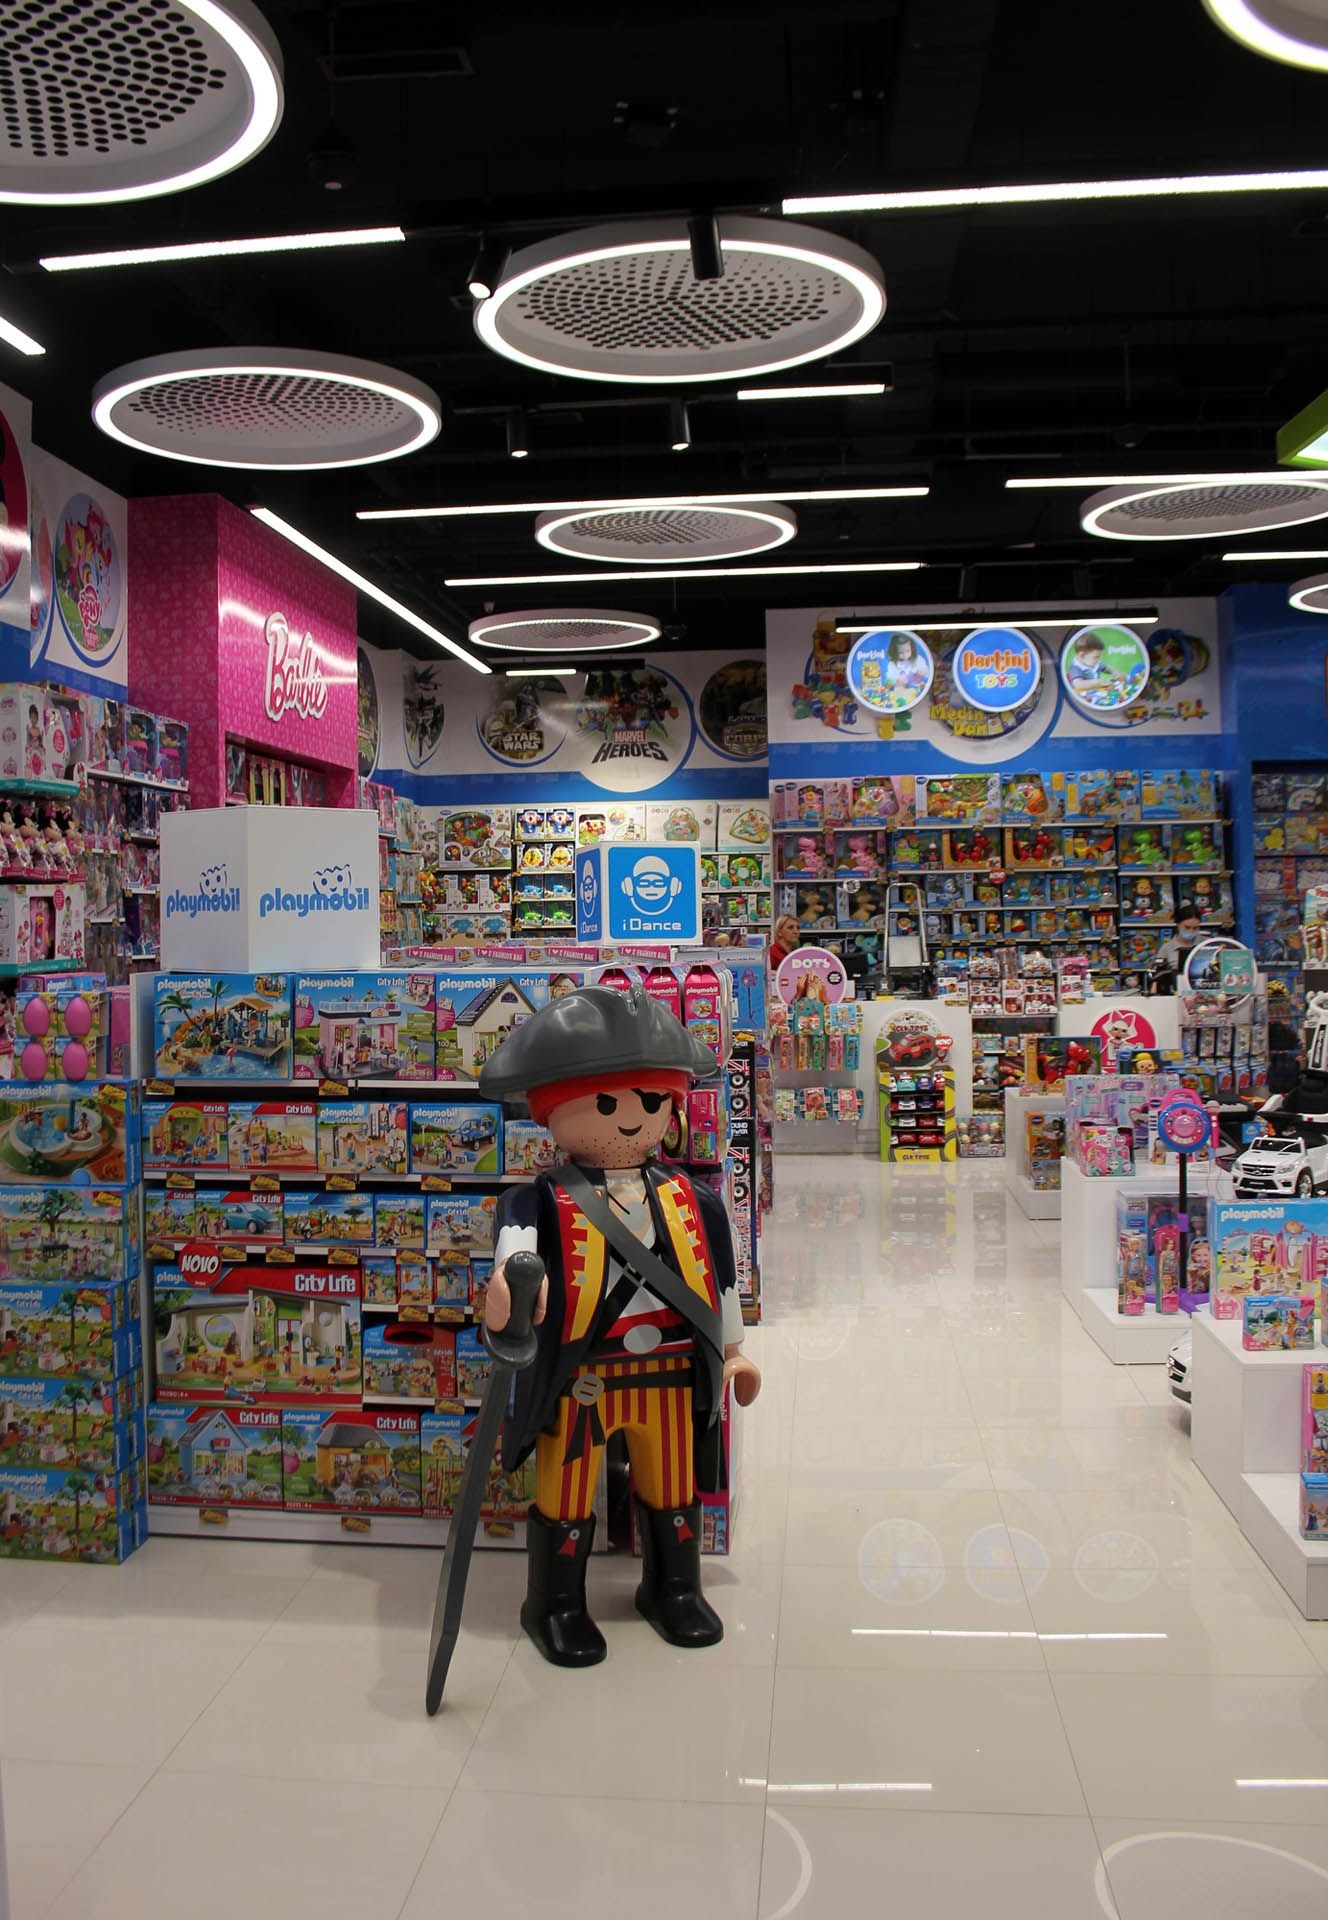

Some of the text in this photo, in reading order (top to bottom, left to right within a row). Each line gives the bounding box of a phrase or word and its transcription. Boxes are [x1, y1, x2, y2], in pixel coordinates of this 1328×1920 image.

[265, 612, 328, 720] Barbie
[975, 674, 1017, 689] TOYS
[503, 732, 540, 741] STAR
[614, 731, 647, 742] MARVEL
[503, 740, 542, 750] WARS
[591, 742, 669, 763] HEROES
[166, 889, 240, 918] playmobil
[260, 888, 369, 918] playmobil
[791, 958, 831, 968] DOTS
[157, 977, 211, 990] playmobil
[299, 976, 354, 988] playmobil
[439, 978, 497, 990] playmobil
[519, 978, 534, 988] City
[686, 987, 719, 995] playmobil
[0, 1085, 51, 1099] playmobil
[320, 1108, 364, 1119] playmobil
[413, 1108, 458, 1119] playmobil
[508, 1125, 547, 1135] playmobil
[252, 1194, 267, 1203] City
[431, 1200, 469, 1209] playmobil
[1221, 1207, 1285, 1222] playmobil
[180, 1254, 219, 1274] NOVO
[294, 1274, 356, 1293] City Life
[239, 1411, 279, 1425] City Life
[283, 1413, 321, 1422] playmobil
[376, 1417, 417, 1430] City Life
